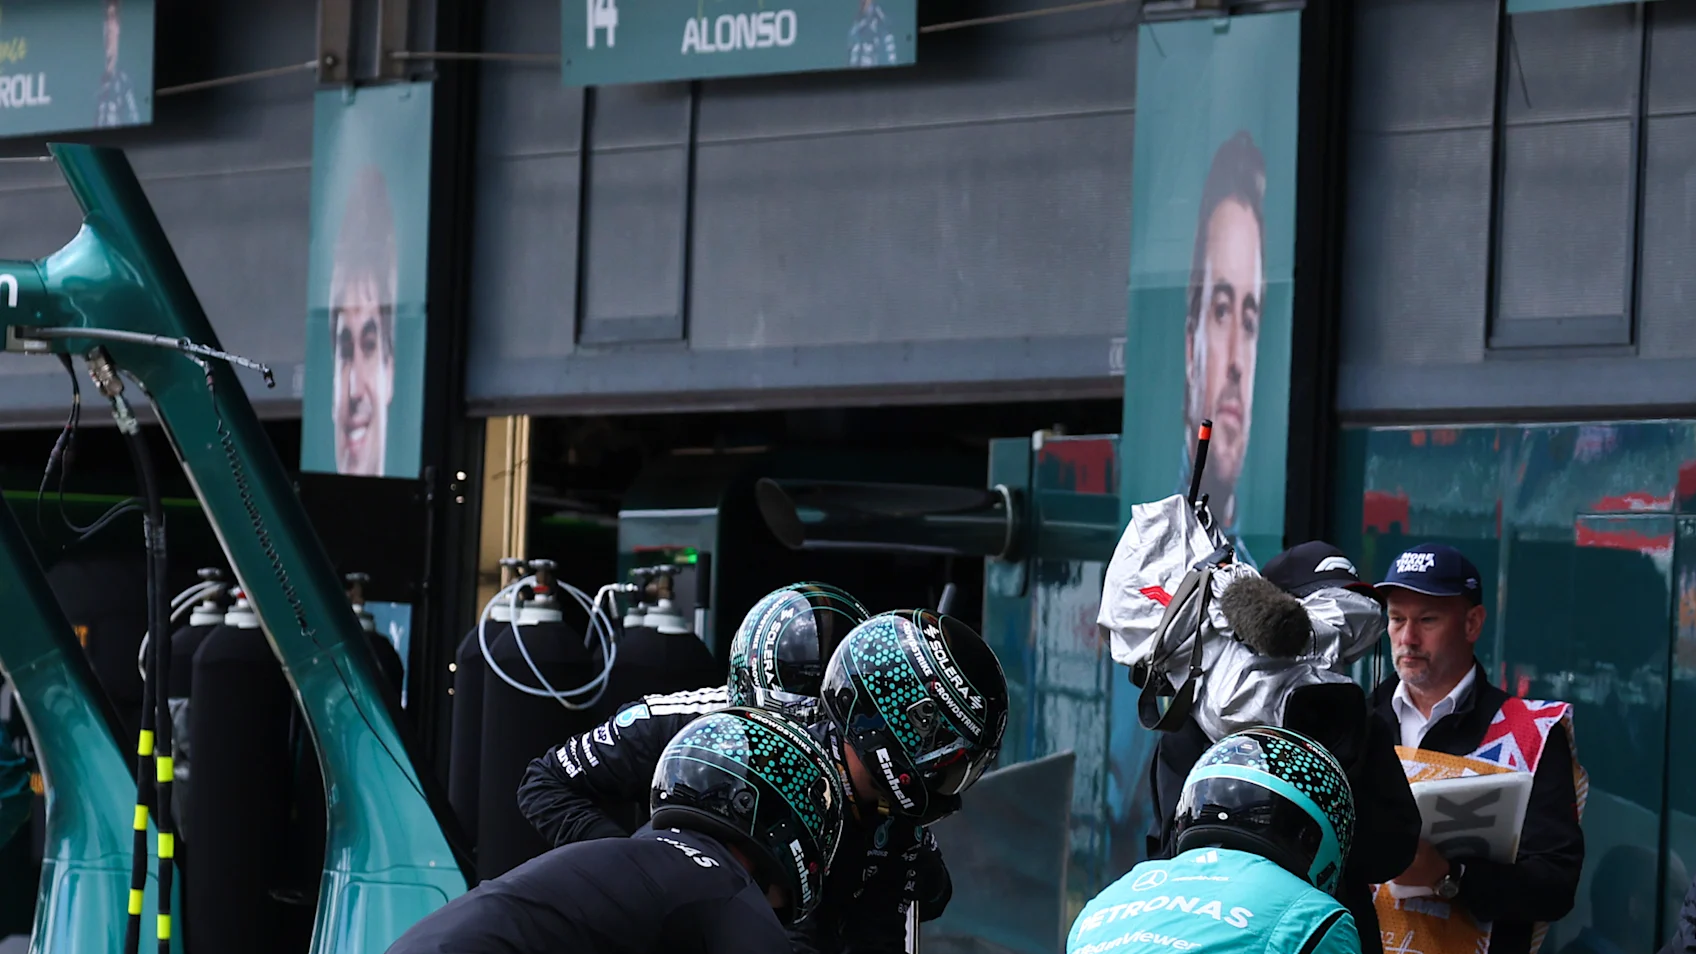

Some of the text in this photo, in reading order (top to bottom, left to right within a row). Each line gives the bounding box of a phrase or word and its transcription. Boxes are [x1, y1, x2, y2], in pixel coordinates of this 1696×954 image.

[681, 9, 798, 55] ALONSO
[0, 71, 52, 108] ROLL
[1396, 558, 1424, 567] THAN
[1397, 564, 1427, 573] RACE
[1401, 552, 1435, 561] MORE
[763, 620, 782, 685] SOLERA
[902, 620, 934, 678] CROWDSTRIKE
[929, 639, 971, 700] SOLERA
[933, 680, 982, 738] CROWDSTRIKE
[749, 712, 813, 755] CROWDSTRIKE
[876, 747, 915, 810] Einhell
[788, 838, 813, 904] Einhell
[1076, 895, 1254, 942] PETRONAS
